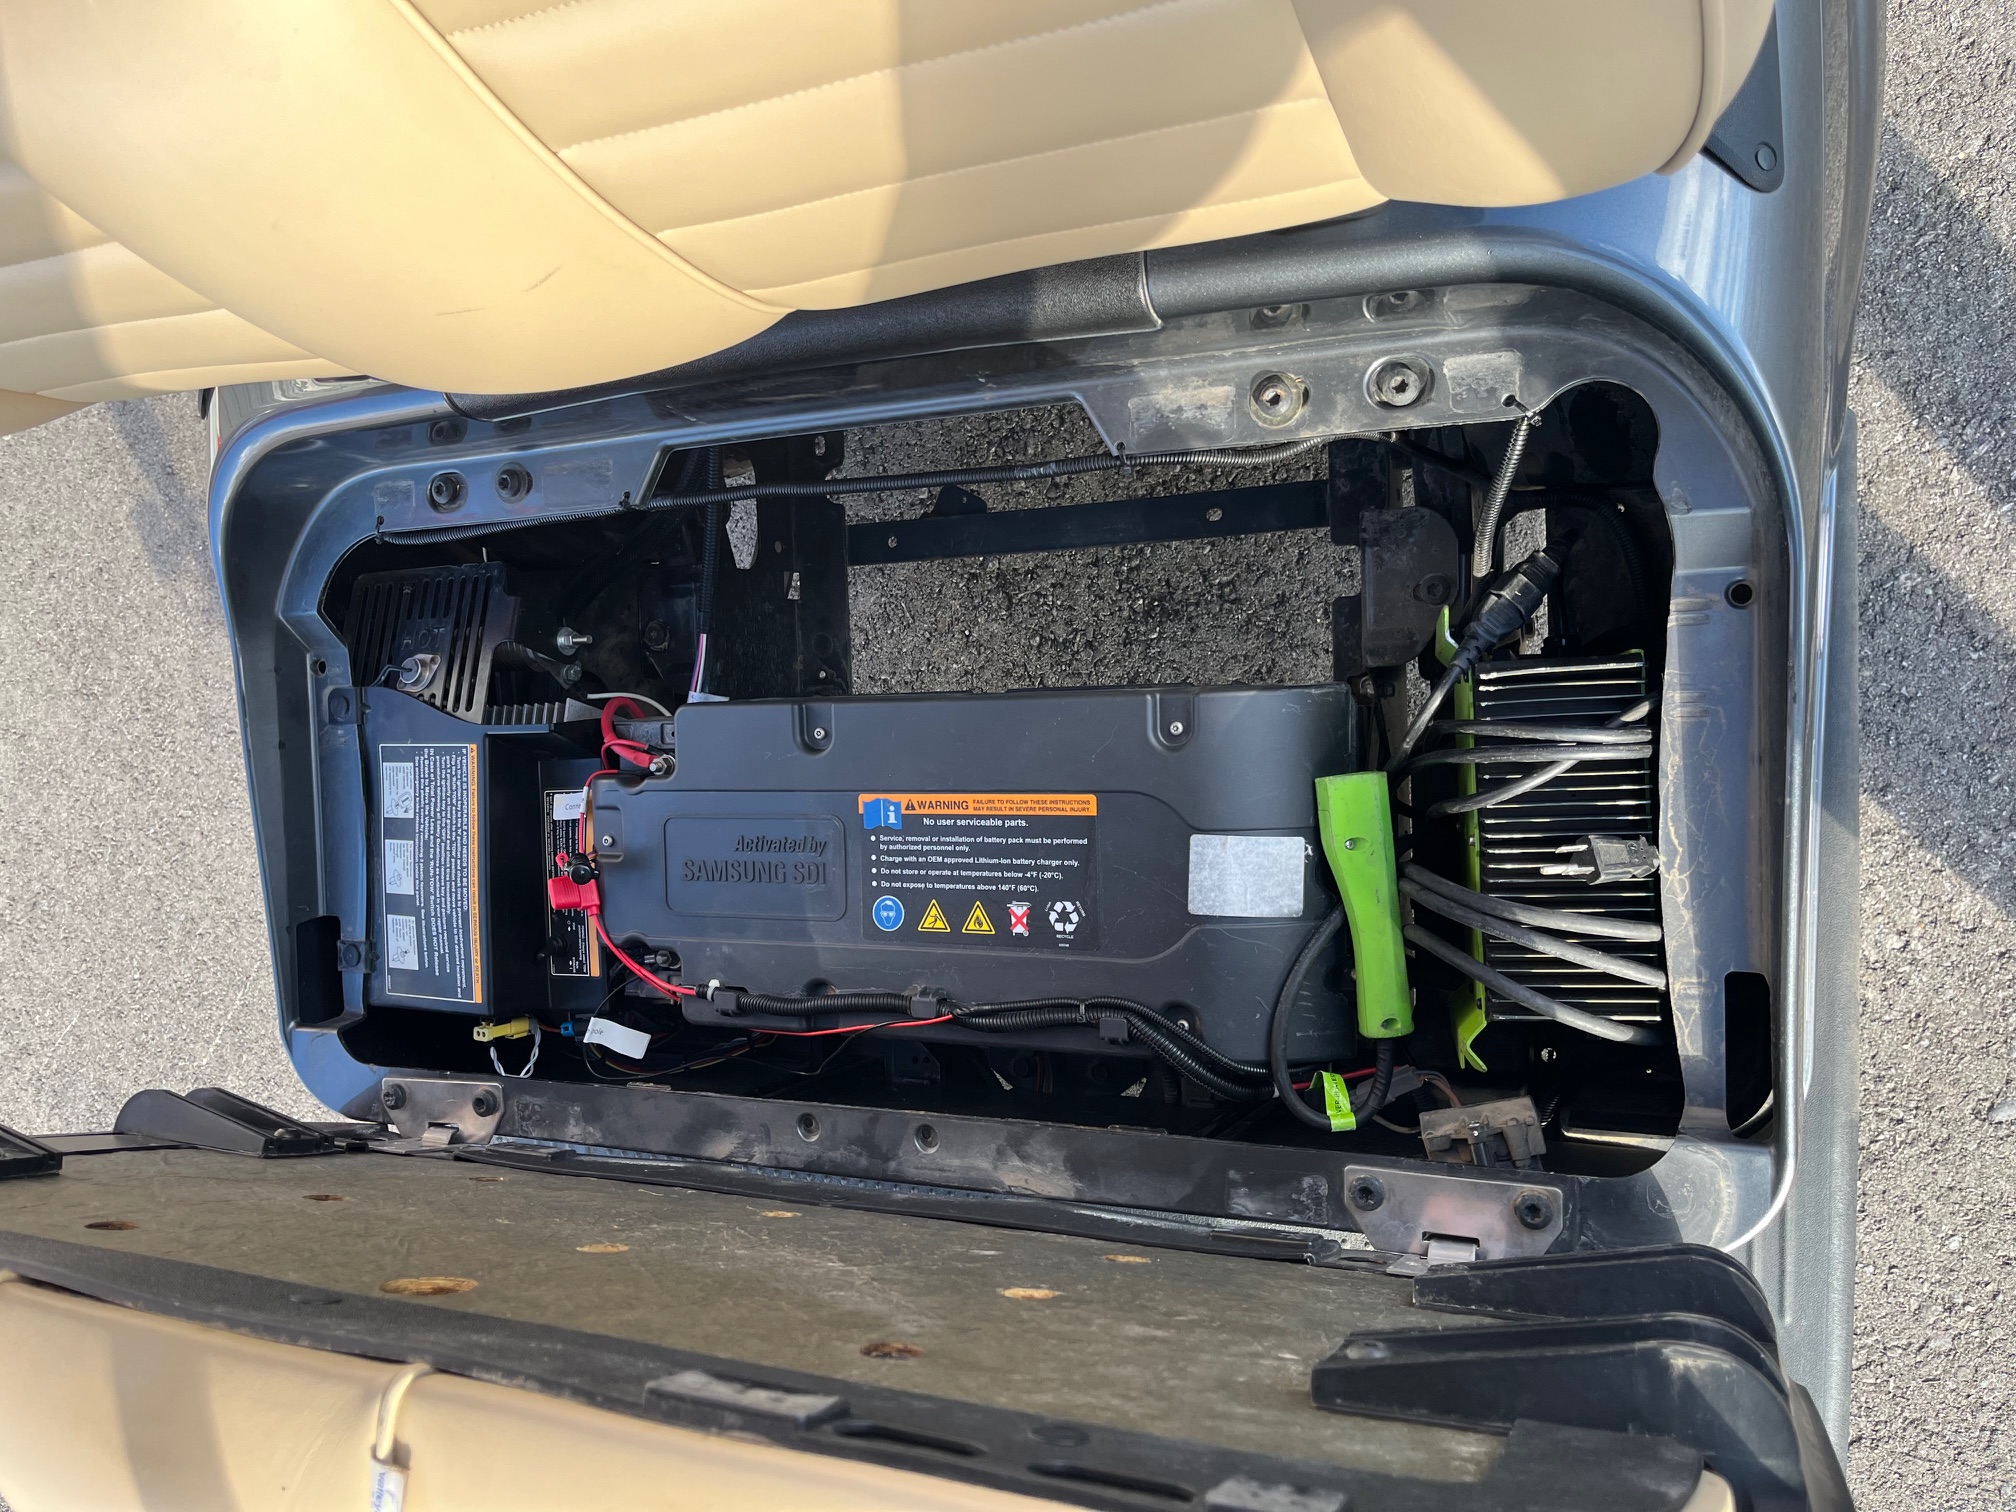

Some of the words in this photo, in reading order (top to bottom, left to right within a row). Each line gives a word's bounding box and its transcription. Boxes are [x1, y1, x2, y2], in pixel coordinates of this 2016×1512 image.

[401, 626, 446, 651] HOT
[917, 800, 969, 810] WARNING
[923, 817, 935, 826] No
[956, 818, 1003, 826] serviceable
[1005, 819, 1030, 828] parts.
[984, 836, 1006, 844] battery
[1008, 836, 1024, 844] pack
[734, 834, 806, 854] Activated
[809, 837, 827, 858] by
[880, 843, 888, 851] by
[880, 855, 902, 863] Charge
[1012, 858, 1035, 866] battery
[1063, 859, 1080, 867] only.
[683, 858, 786, 884] SAMSUNG
[792, 861, 826, 885] SDI
